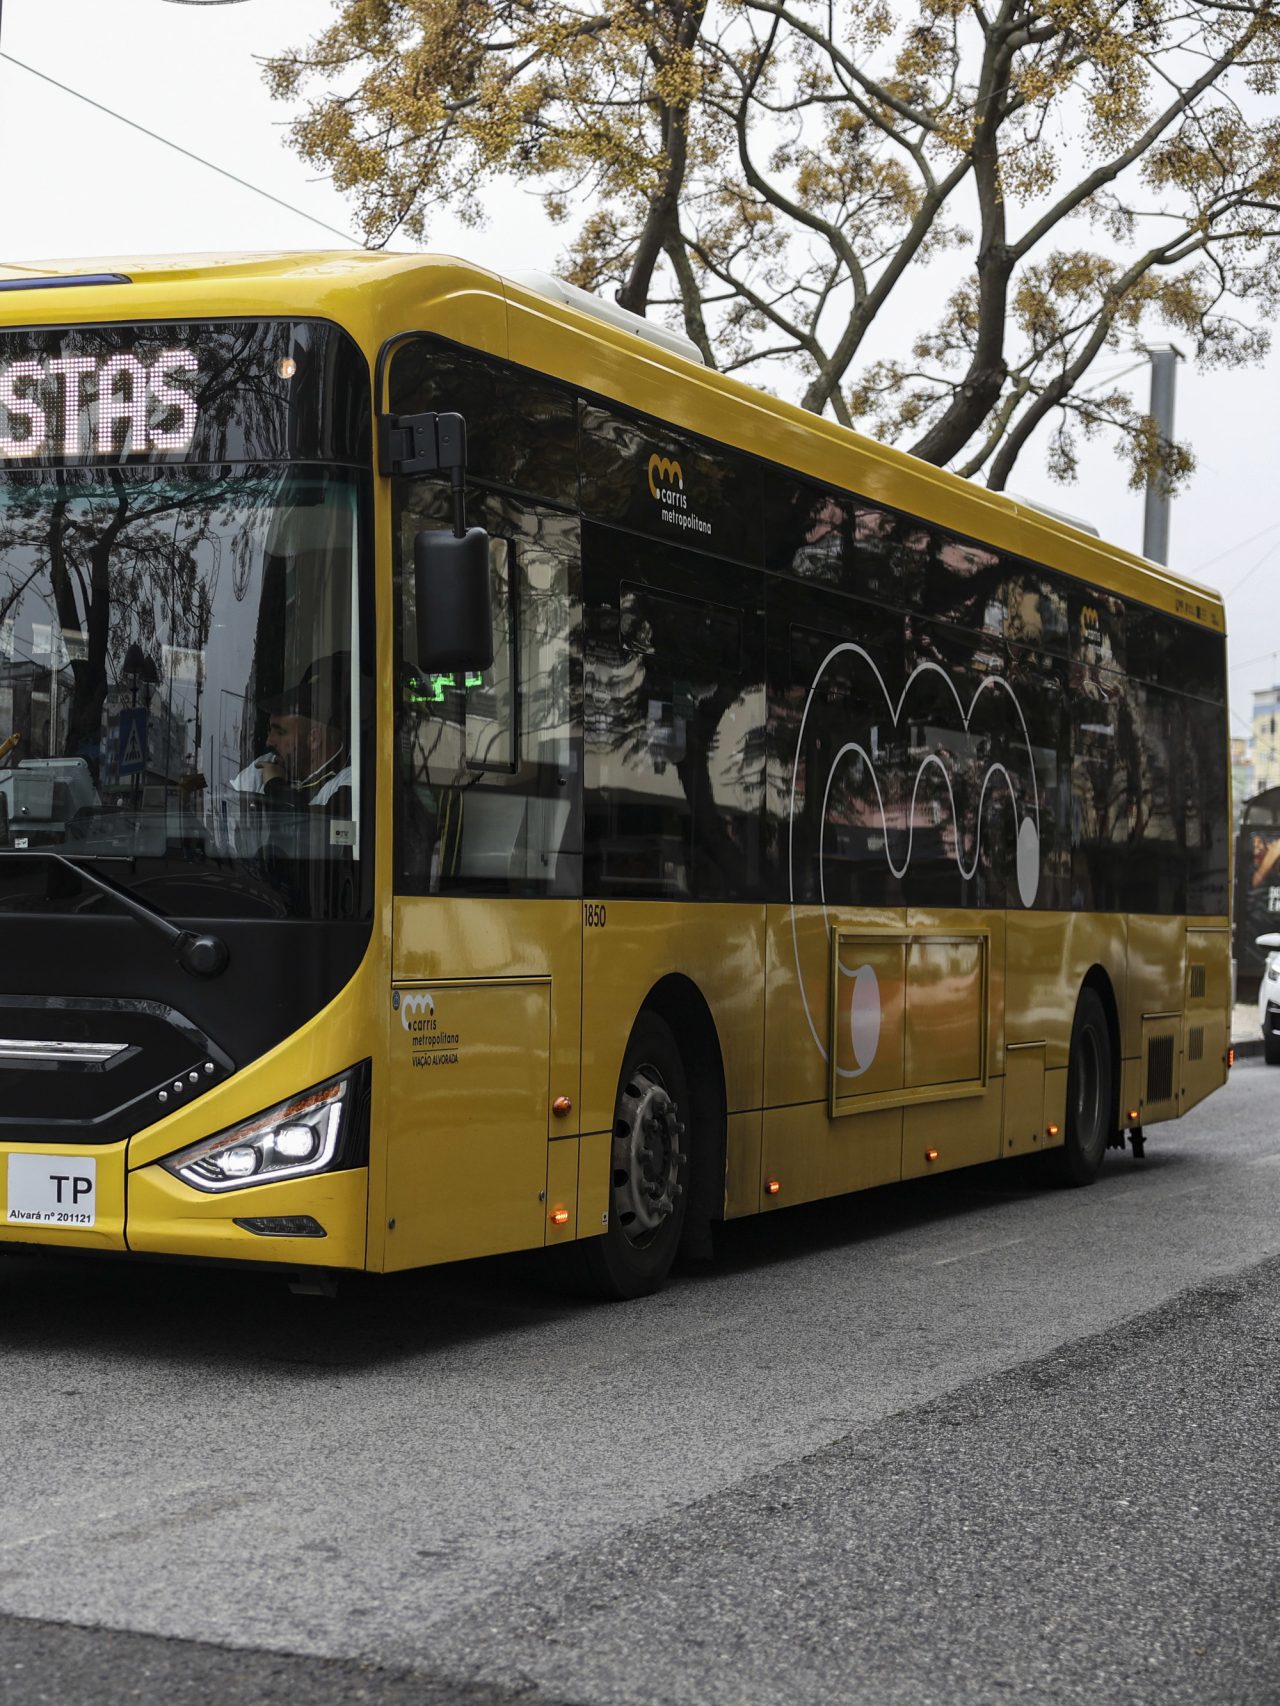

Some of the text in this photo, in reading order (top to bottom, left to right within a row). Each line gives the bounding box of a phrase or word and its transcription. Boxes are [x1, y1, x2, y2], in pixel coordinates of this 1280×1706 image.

[661, 489, 687, 509] carris
[661, 509, 712, 534] metropolitana
[584, 904, 607, 928] 1850
[412, 1019, 437, 1031] carris
[412, 1031, 459, 1048] metropolitana
[412, 1053, 458, 1069] VIAÇÃO ALVORADA
[49, 1175, 93, 1204] TP
[9, 1210, 41, 1220] Alvará
[57, 1213, 92, 1223] 201121
